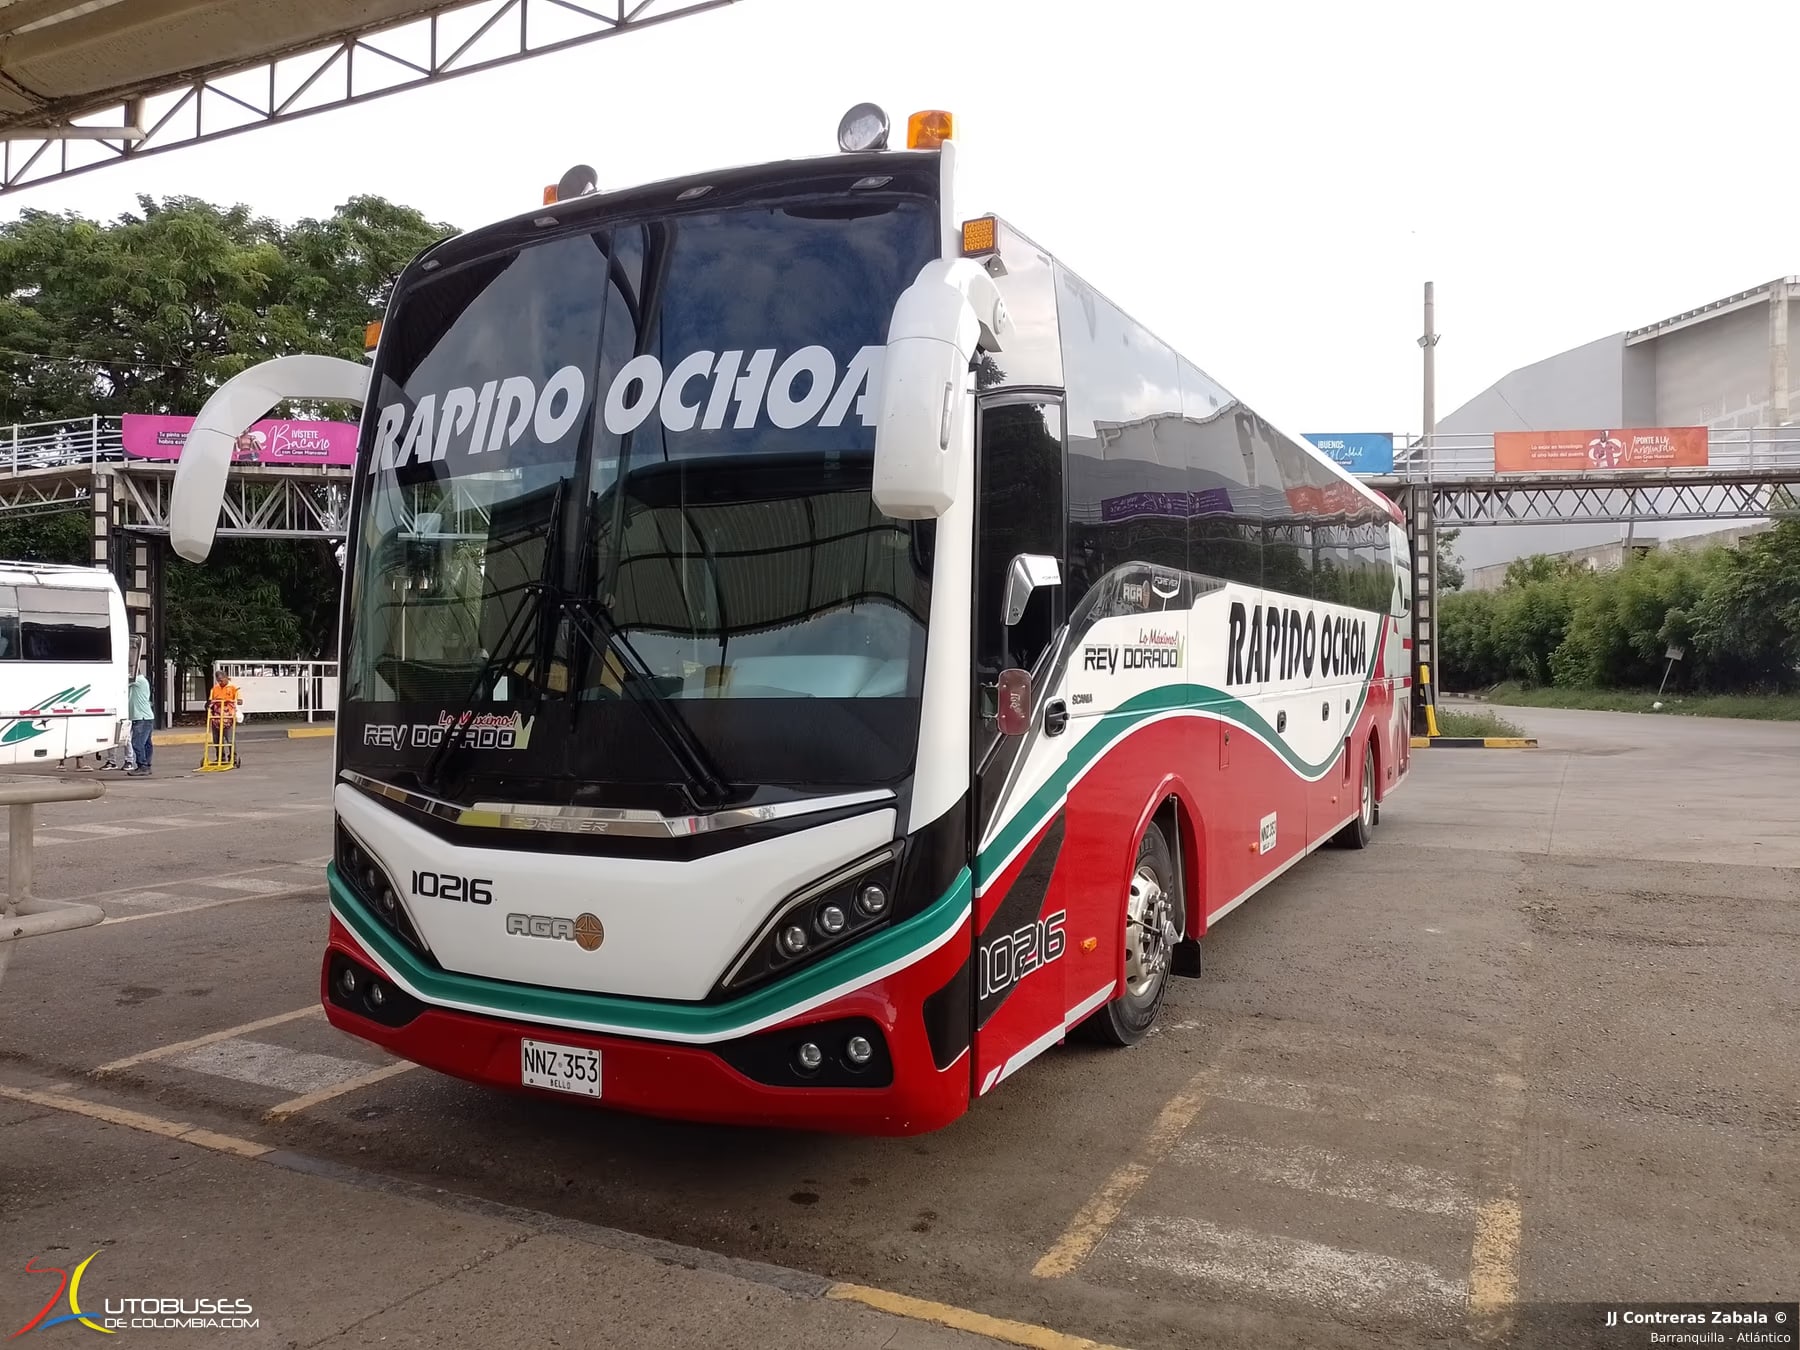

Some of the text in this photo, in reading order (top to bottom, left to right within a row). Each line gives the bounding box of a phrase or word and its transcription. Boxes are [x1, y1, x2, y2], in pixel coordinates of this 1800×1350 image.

[369, 345, 888, 475] RAPIDO OCHOA
[268, 425, 330, 457] Bacano
[1123, 583, 1143, 602] AGA
[1226, 601, 1366, 686] RAPIDO OCHOA
[1084, 646, 1178, 675] REY DORADO
[364, 724, 408, 751] REY
[411, 870, 493, 906] 10216
[506, 912, 577, 941] AGA
[980, 909, 1066, 1000] 10216
[525, 1047, 598, 1083] NNZ 353
[550, 1078, 571, 1090] BELLO
